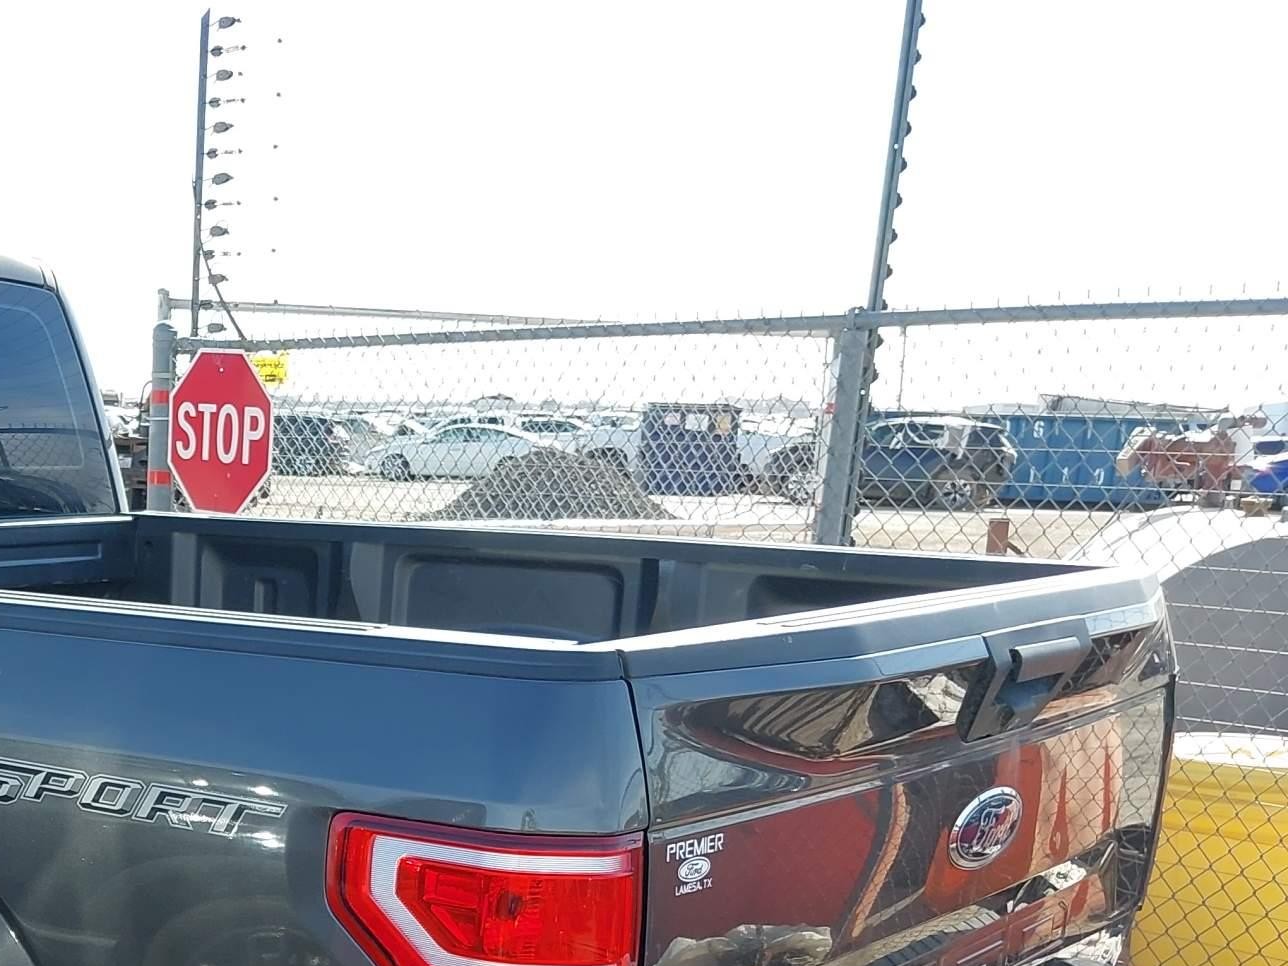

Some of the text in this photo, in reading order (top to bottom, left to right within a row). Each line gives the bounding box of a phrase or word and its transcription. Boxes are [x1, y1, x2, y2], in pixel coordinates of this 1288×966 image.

[175, 401, 266, 465] STOP
[666, 833, 724, 863] PREMIER
[703, 878, 713, 889] TX
